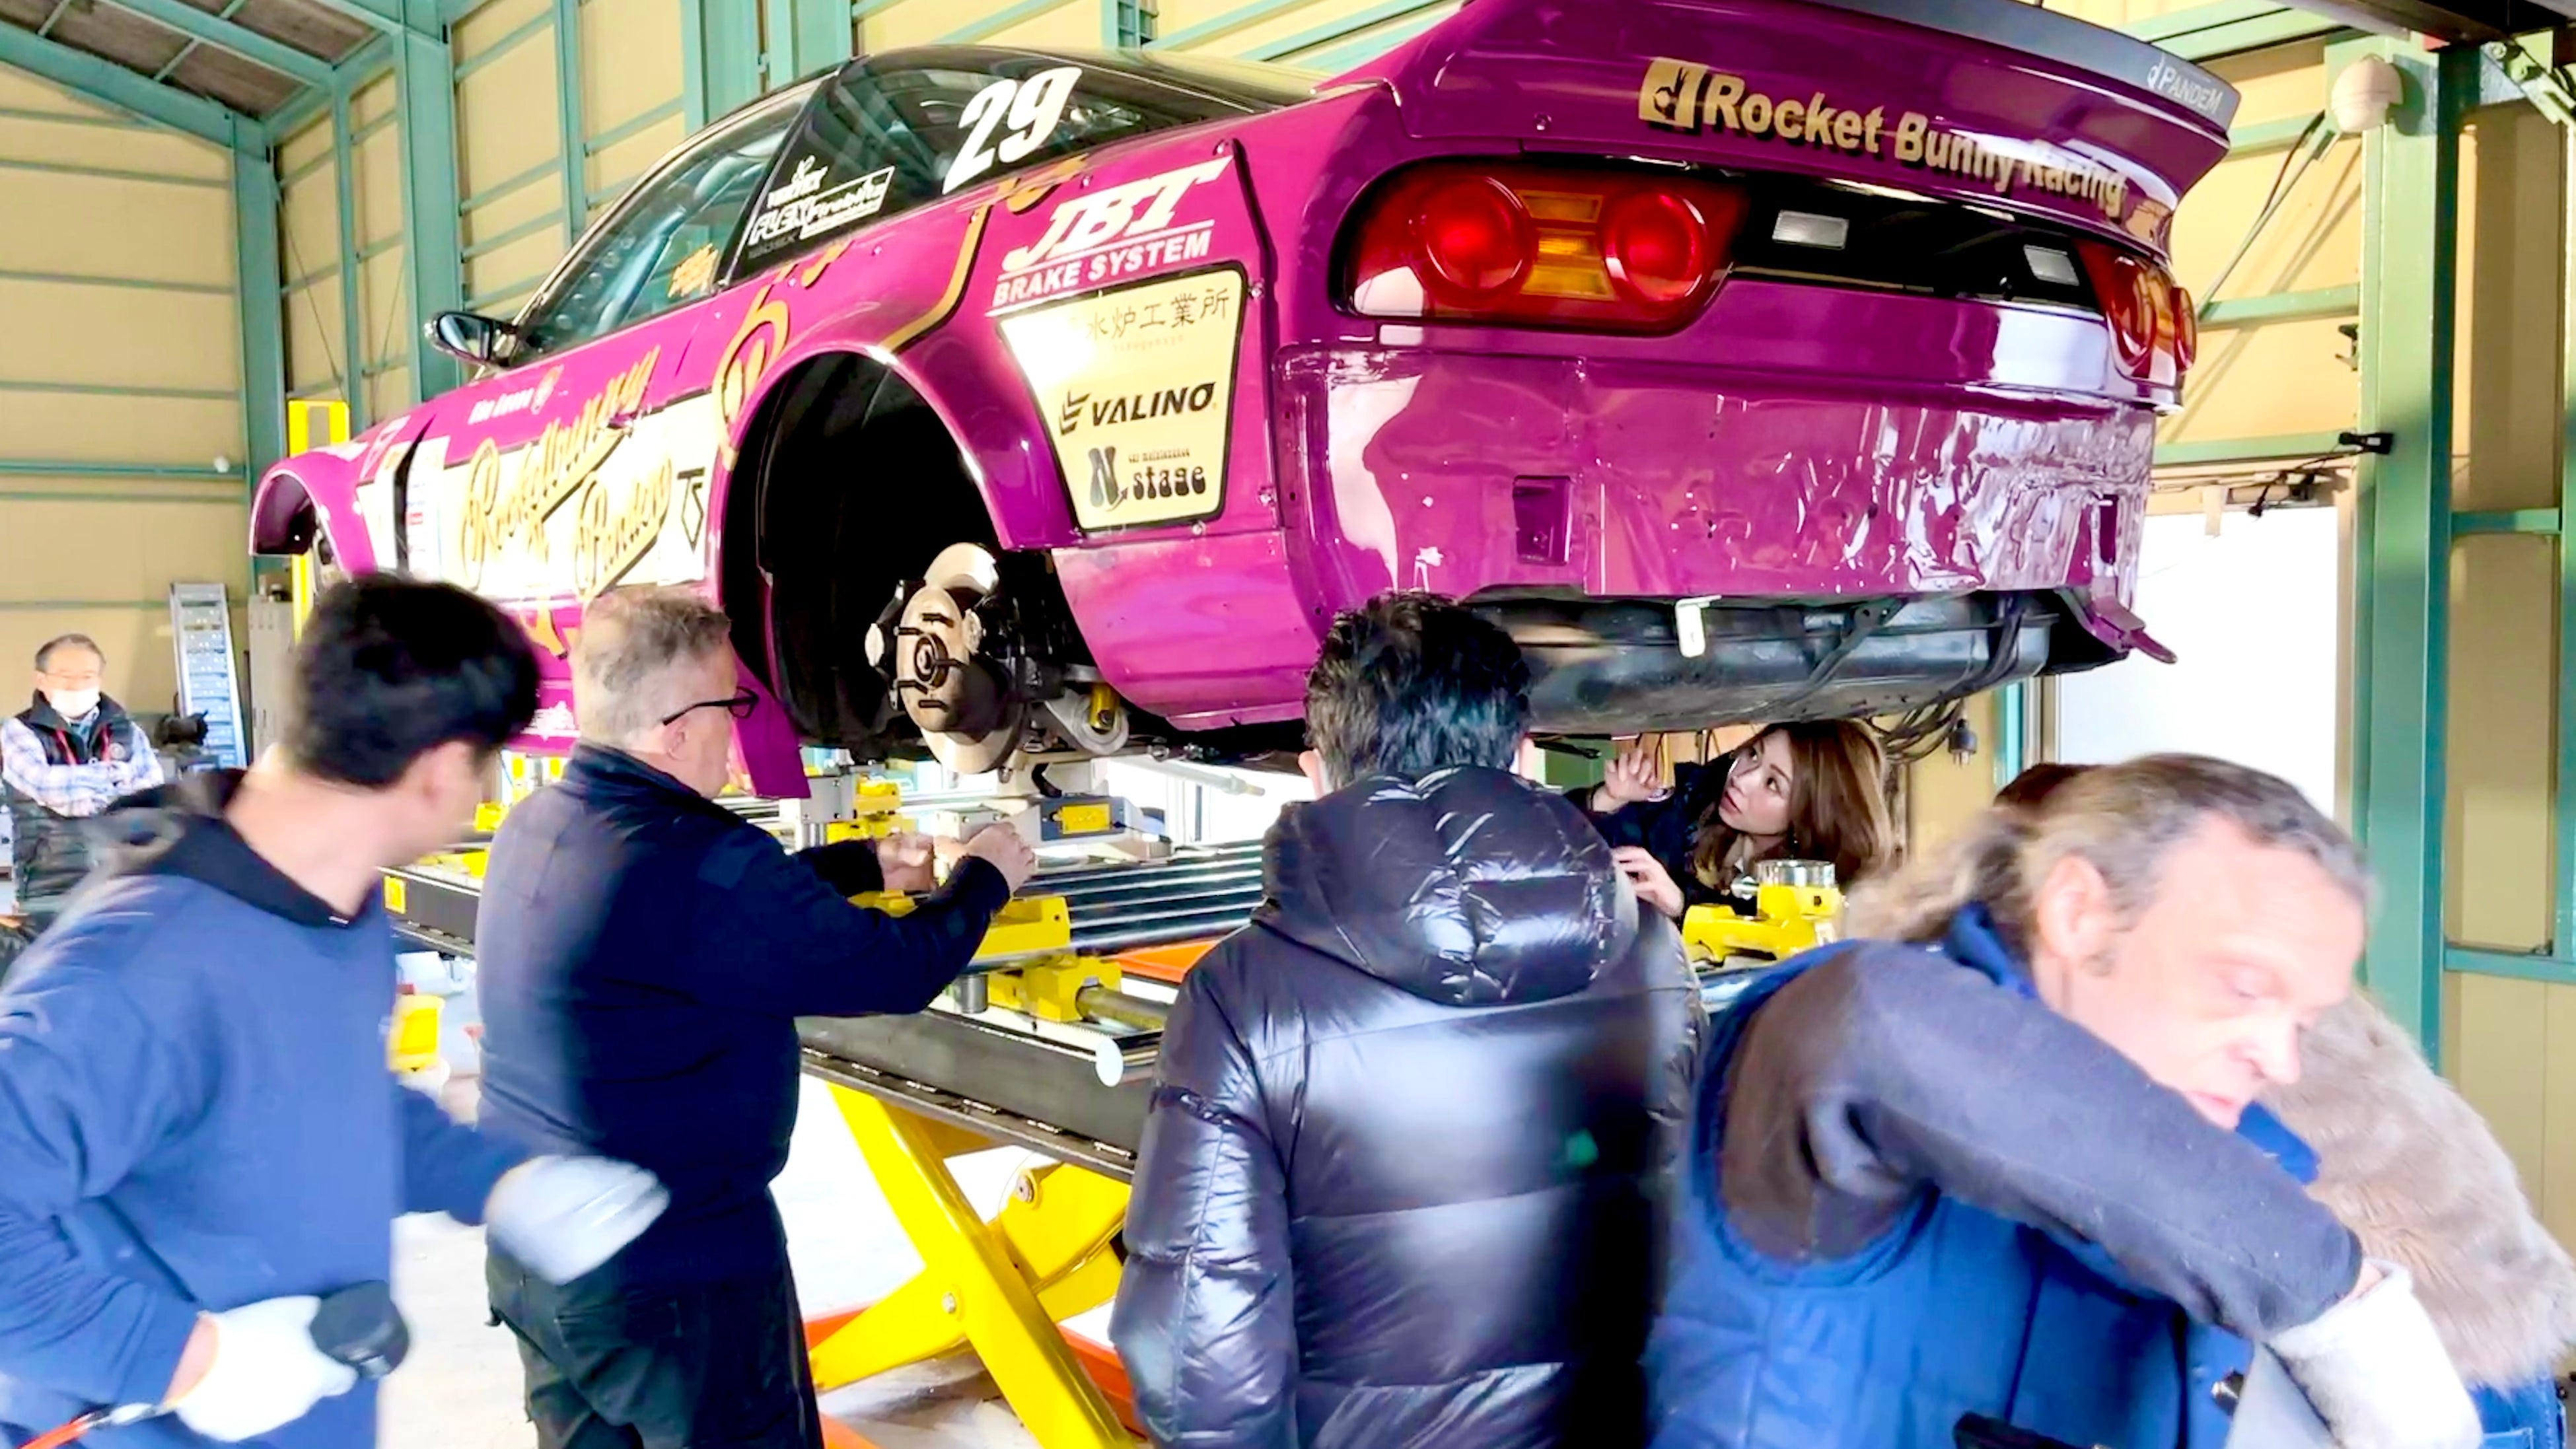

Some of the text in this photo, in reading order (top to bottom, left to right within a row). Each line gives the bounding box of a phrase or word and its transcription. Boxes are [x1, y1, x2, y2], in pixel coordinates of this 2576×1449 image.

[942, 66, 1083, 195] 29
[1702, 73, 2128, 218] Rocket Bunny Racing
[1001, 155, 1234, 272] JBT
[992, 230, 1212, 308] BRAKE SYSTEM
[1082, 287, 1229, 340] 水炉工業所
[1092, 381, 1217, 427] VALINO
[1133, 466, 1206, 500] stage
